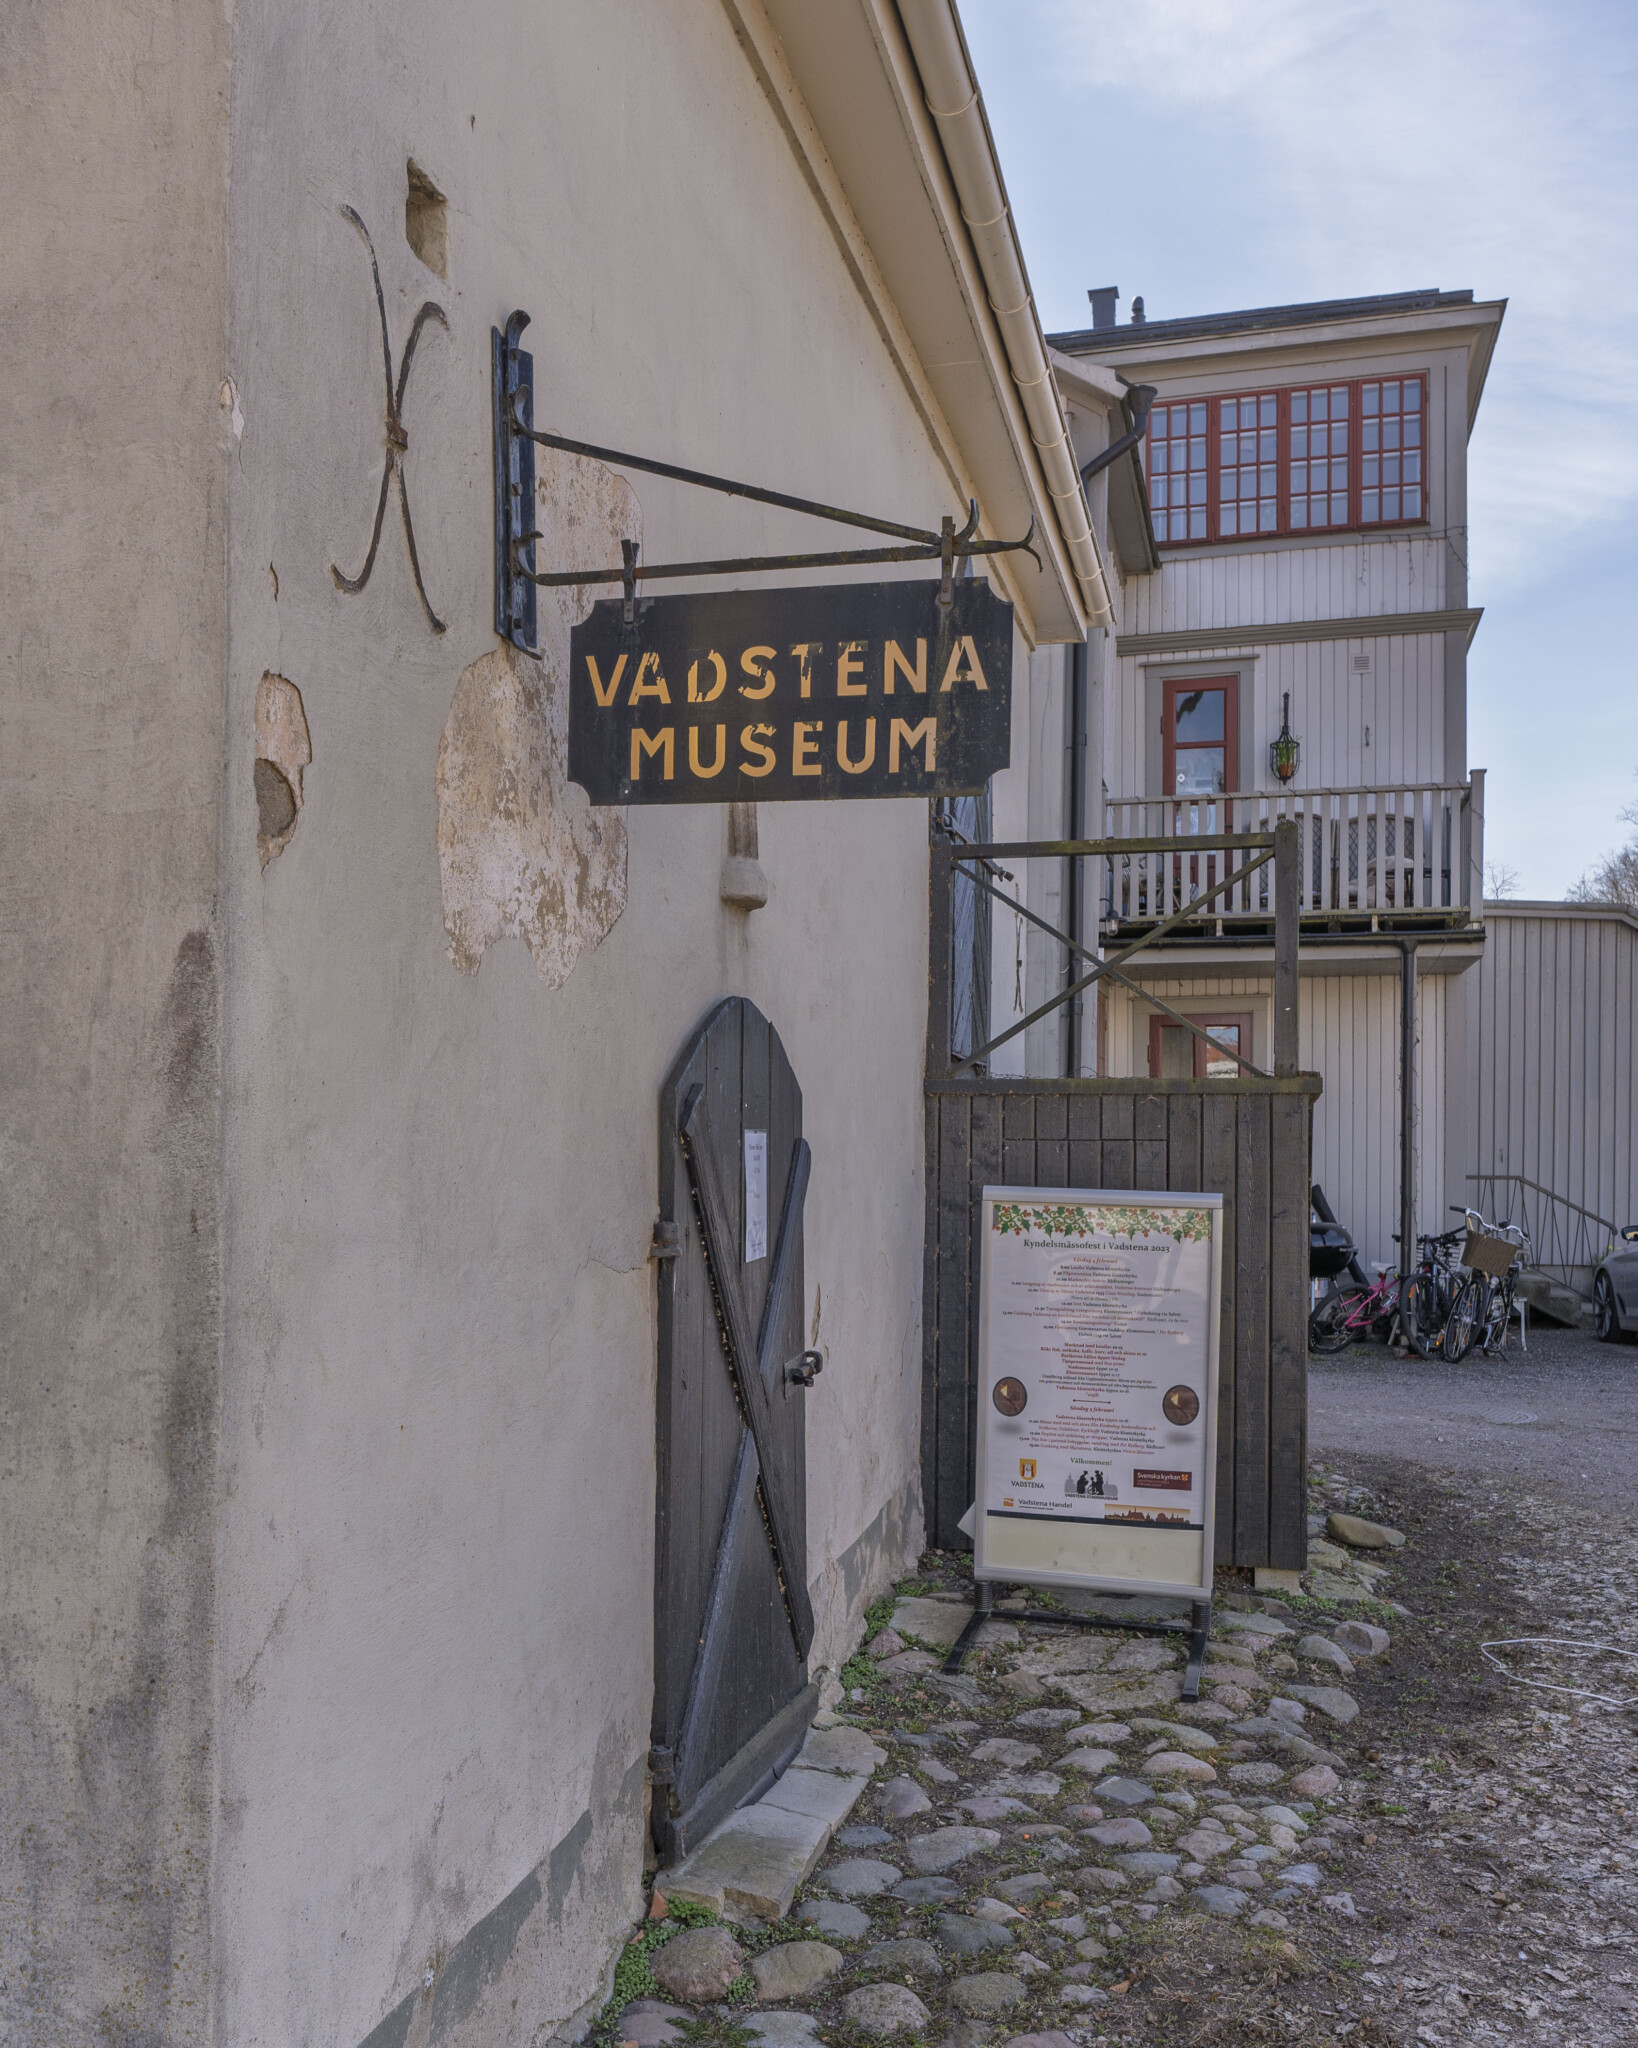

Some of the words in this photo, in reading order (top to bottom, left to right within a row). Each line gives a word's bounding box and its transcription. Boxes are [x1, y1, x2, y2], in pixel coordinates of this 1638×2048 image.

[585, 635, 988, 707] VADSTENA
[630, 717, 938, 781] MUSEUM
[1024, 1239, 1100, 1250] Kyndelsmässofest
[1108, 1242, 1149, 1252] Vadstena
[1070, 1456, 1112, 1466] Välkommen!
[1010, 1480, 1044, 1489] VADSTENA
[1018, 1499, 1048, 1507] Vadstena
